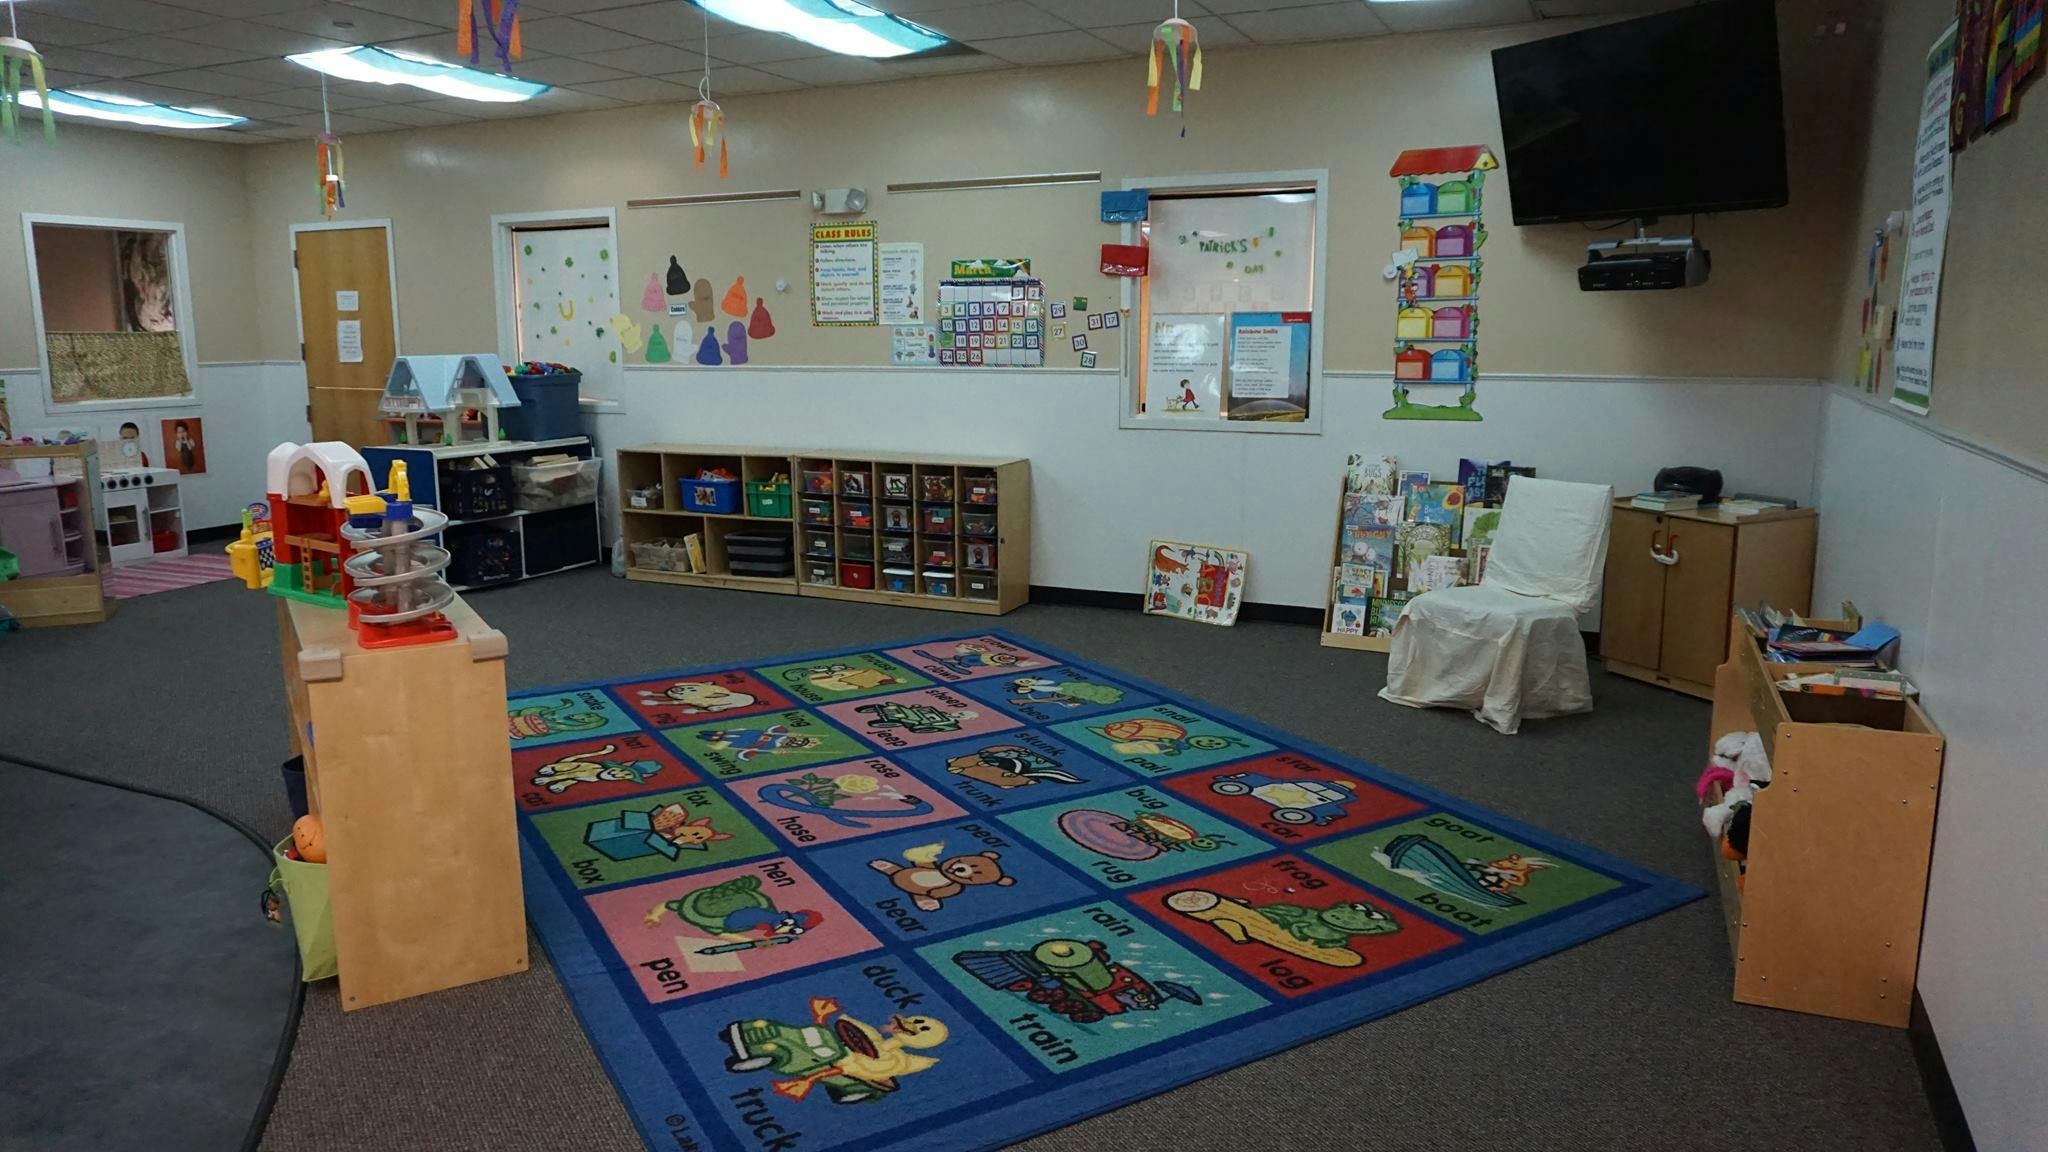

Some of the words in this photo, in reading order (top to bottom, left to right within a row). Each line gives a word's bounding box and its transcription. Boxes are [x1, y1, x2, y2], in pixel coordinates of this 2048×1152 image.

[815, 230, 840, 239] CLASS
[844, 228, 872, 238] RULES
[954, 264, 992, 275] March
[1075, 339, 1084, 347] 30
[979, 637, 1018, 652] crown
[859, 654, 897, 671] mouse
[923, 664, 961, 681] clown
[1057, 667, 1089, 681] tree
[576, 692, 605, 711] snake
[789, 684, 824, 702] house
[925, 688, 968, 709] sheep
[782, 711, 811, 728] king
[1152, 705, 1201, 725] snail
[621, 735, 648, 750] hat
[866, 729, 908, 748] jeep
[1013, 731, 1065, 757] skunk
[703, 751, 742, 776] swing
[863, 758, 901, 780] rose
[1123, 755, 1173, 775] pail
[1275, 755, 1321, 773] star
[521, 792, 551, 807] cat
[682, 790, 712, 808] fox
[954, 780, 1004, 808] trunk
[1125, 787, 1169, 811] bug
[777, 816, 817, 844] hose
[956, 822, 1011, 850] pear
[1260, 820, 1303, 840] car
[1424, 817, 1496, 844] goat
[572, 857, 605, 885] box
[758, 860, 796, 888] hen
[1091, 858, 1137, 885] rug
[1271, 859, 1329, 891] frog
[875, 897, 928, 936] bear
[1414, 892, 1496, 929] boat
[1082, 906, 1136, 938] rain
[640, 956, 690, 995] pen
[1259, 957, 1314, 991] log
[861, 963, 926, 1010] duck
[1009, 1012, 1079, 1066] train
[729, 1087, 802, 1152] truck
